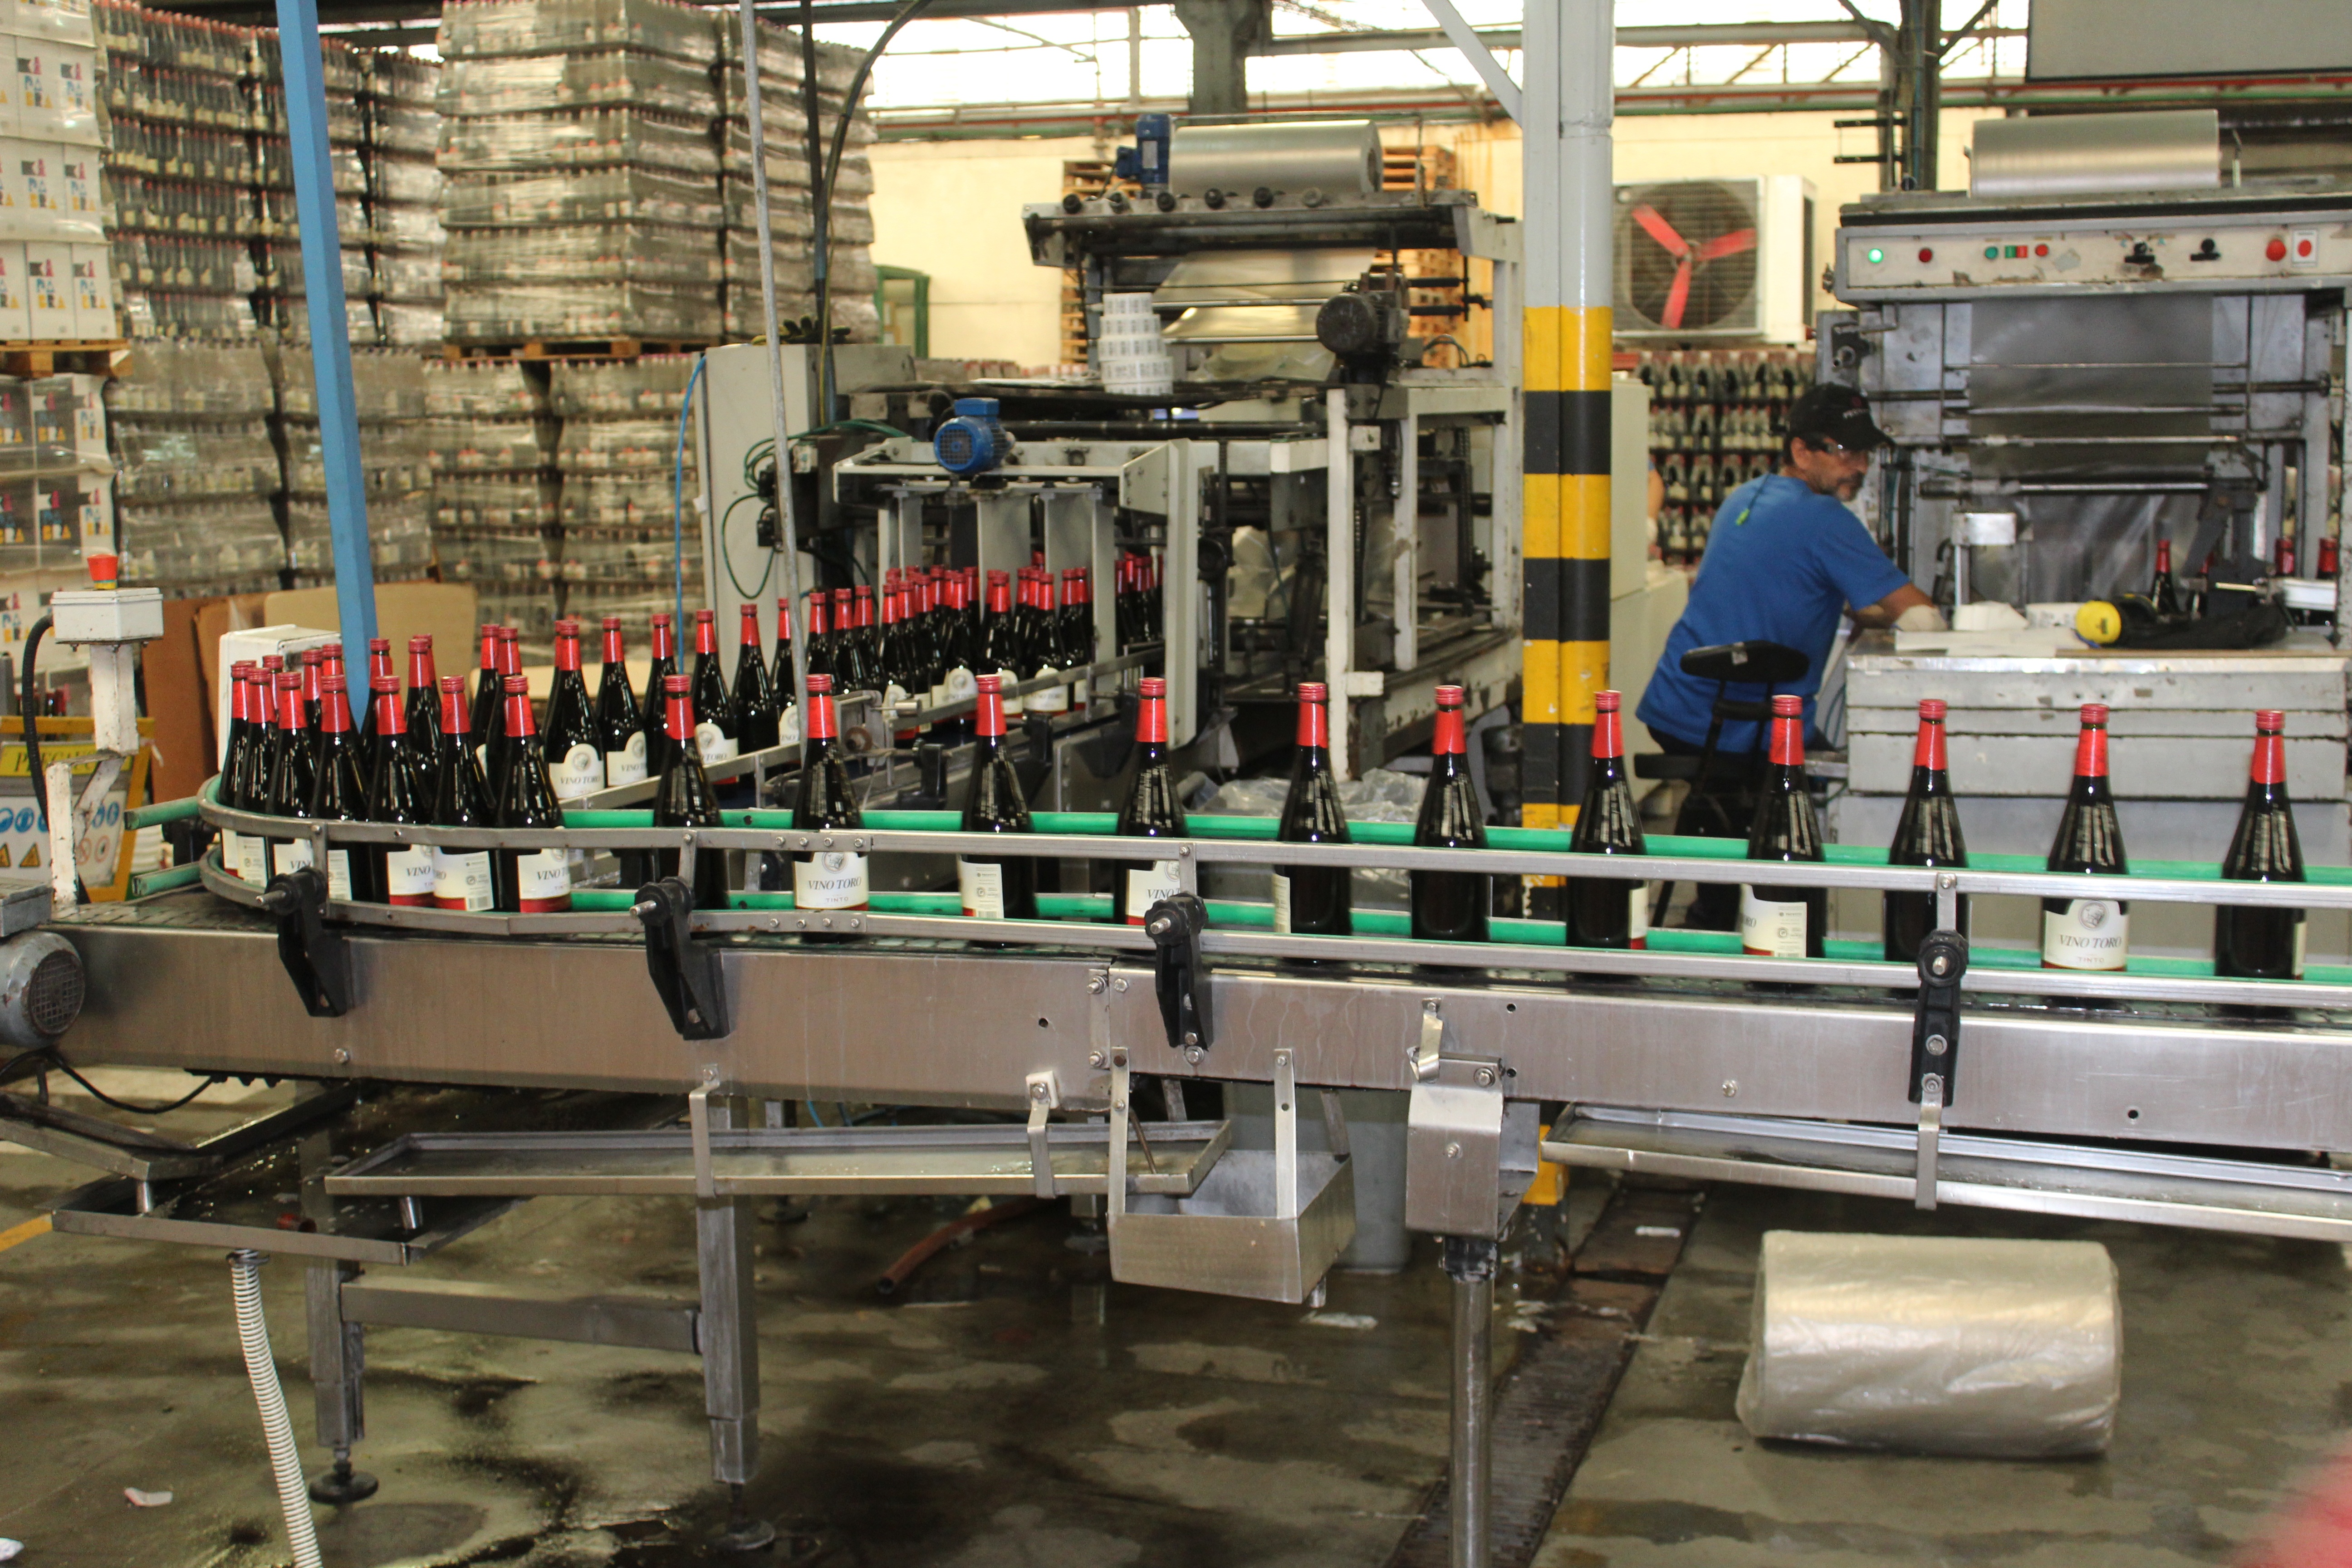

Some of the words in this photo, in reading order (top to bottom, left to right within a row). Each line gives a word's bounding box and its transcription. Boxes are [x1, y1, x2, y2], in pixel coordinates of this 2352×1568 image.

[560, 776, 581, 784] VINO
[582, 775, 600, 784] TORO
[406, 866, 431, 877] VINO
[537, 869, 560, 880] VINO
[808, 880, 834, 890] VINO
[837, 877, 862, 889] TORO
[1147, 888, 1174, 899] VINO
[2060, 934, 2090, 948] VINO
[2092, 936, 2122, 948] TORO
